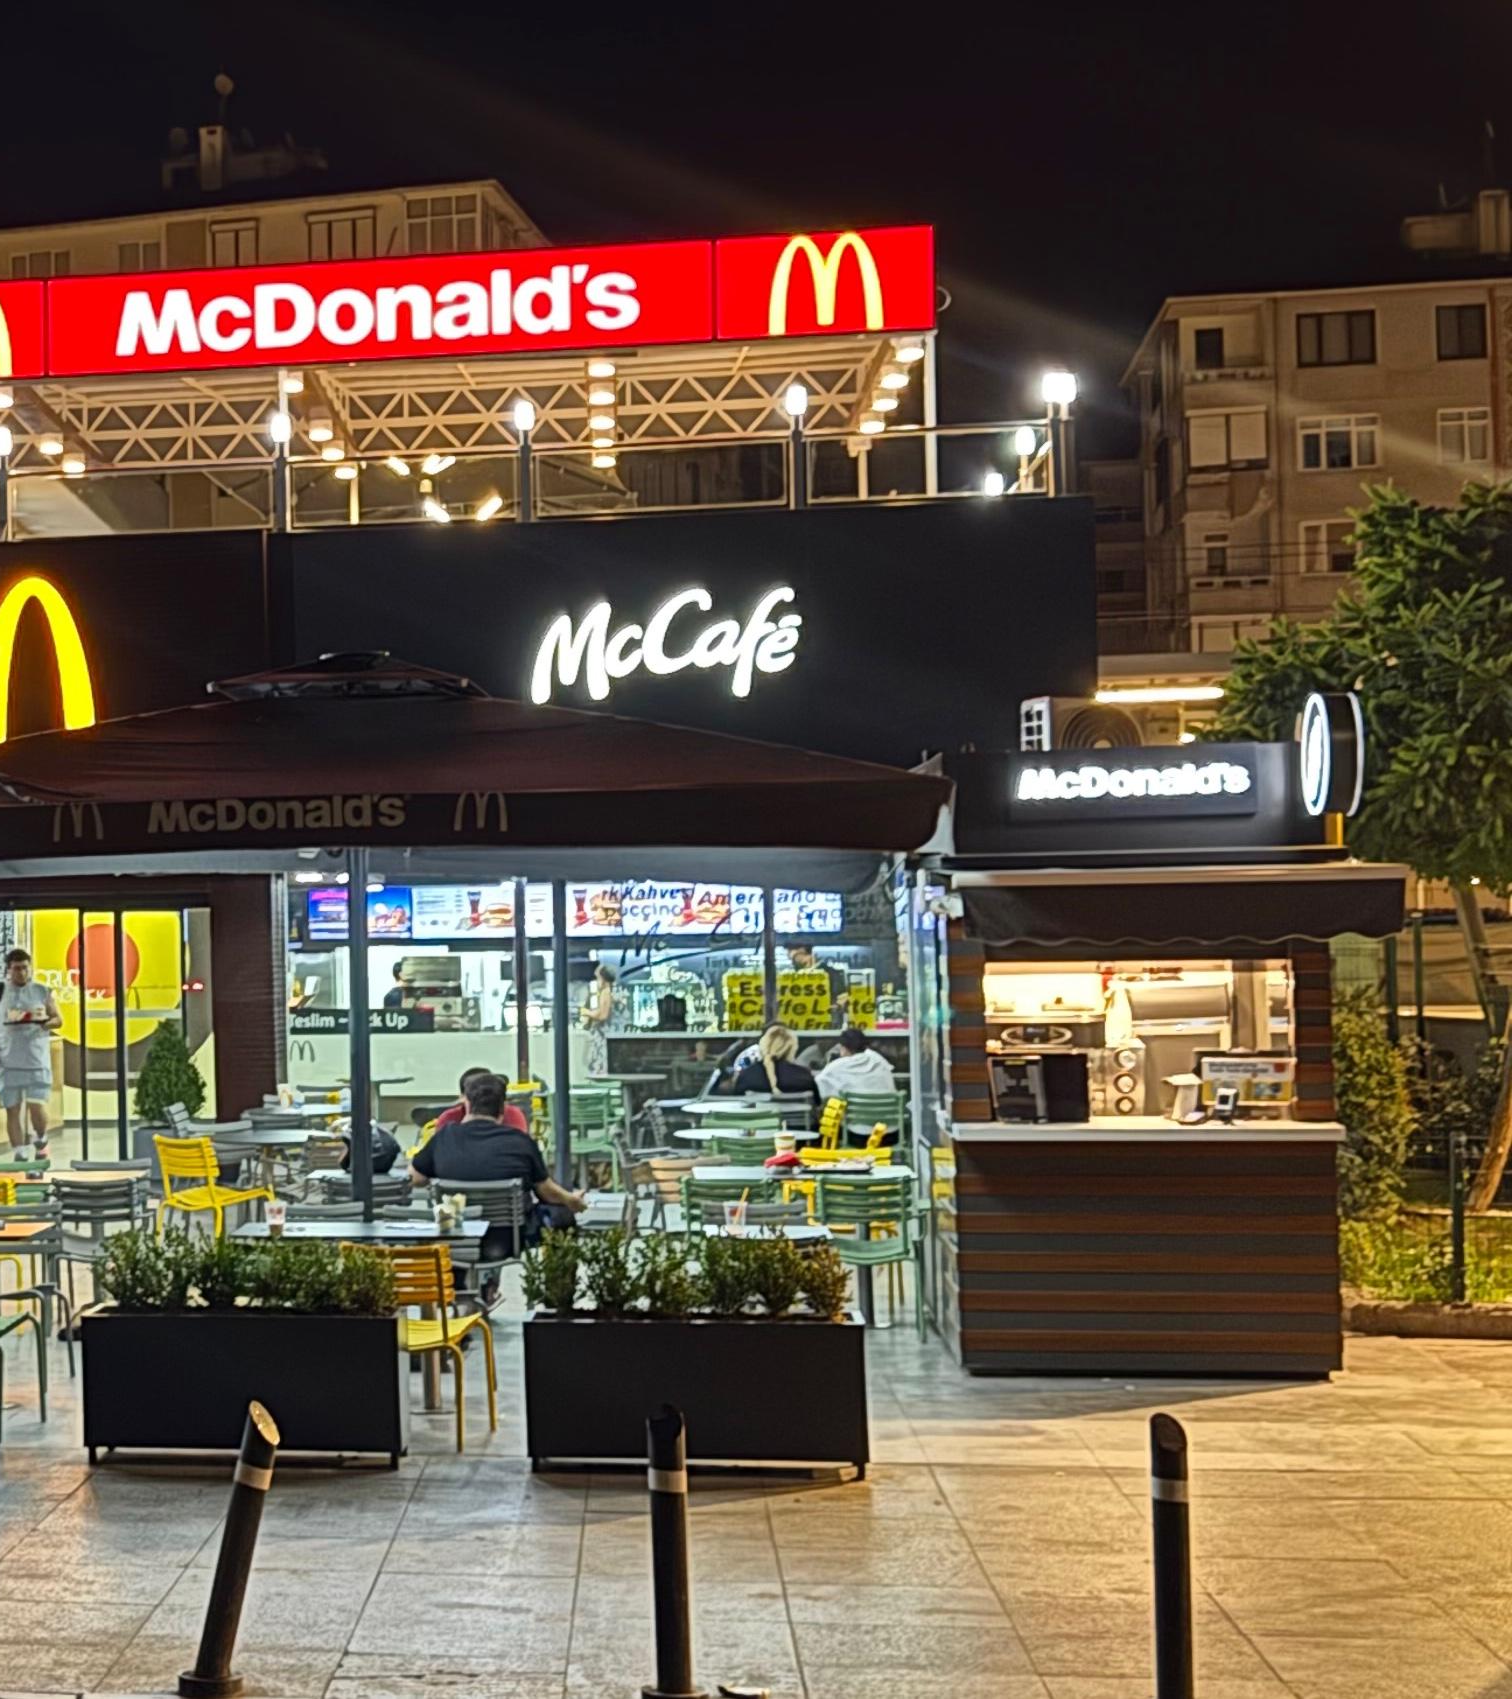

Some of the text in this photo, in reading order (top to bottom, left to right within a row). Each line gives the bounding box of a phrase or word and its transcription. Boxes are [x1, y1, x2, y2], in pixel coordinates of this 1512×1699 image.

[116, 264, 641, 357] McDonald's
[531, 586, 803, 705] McCafé
[147, 794, 406, 834] McDonald's
[1016, 762, 1251, 801] McDonald's
